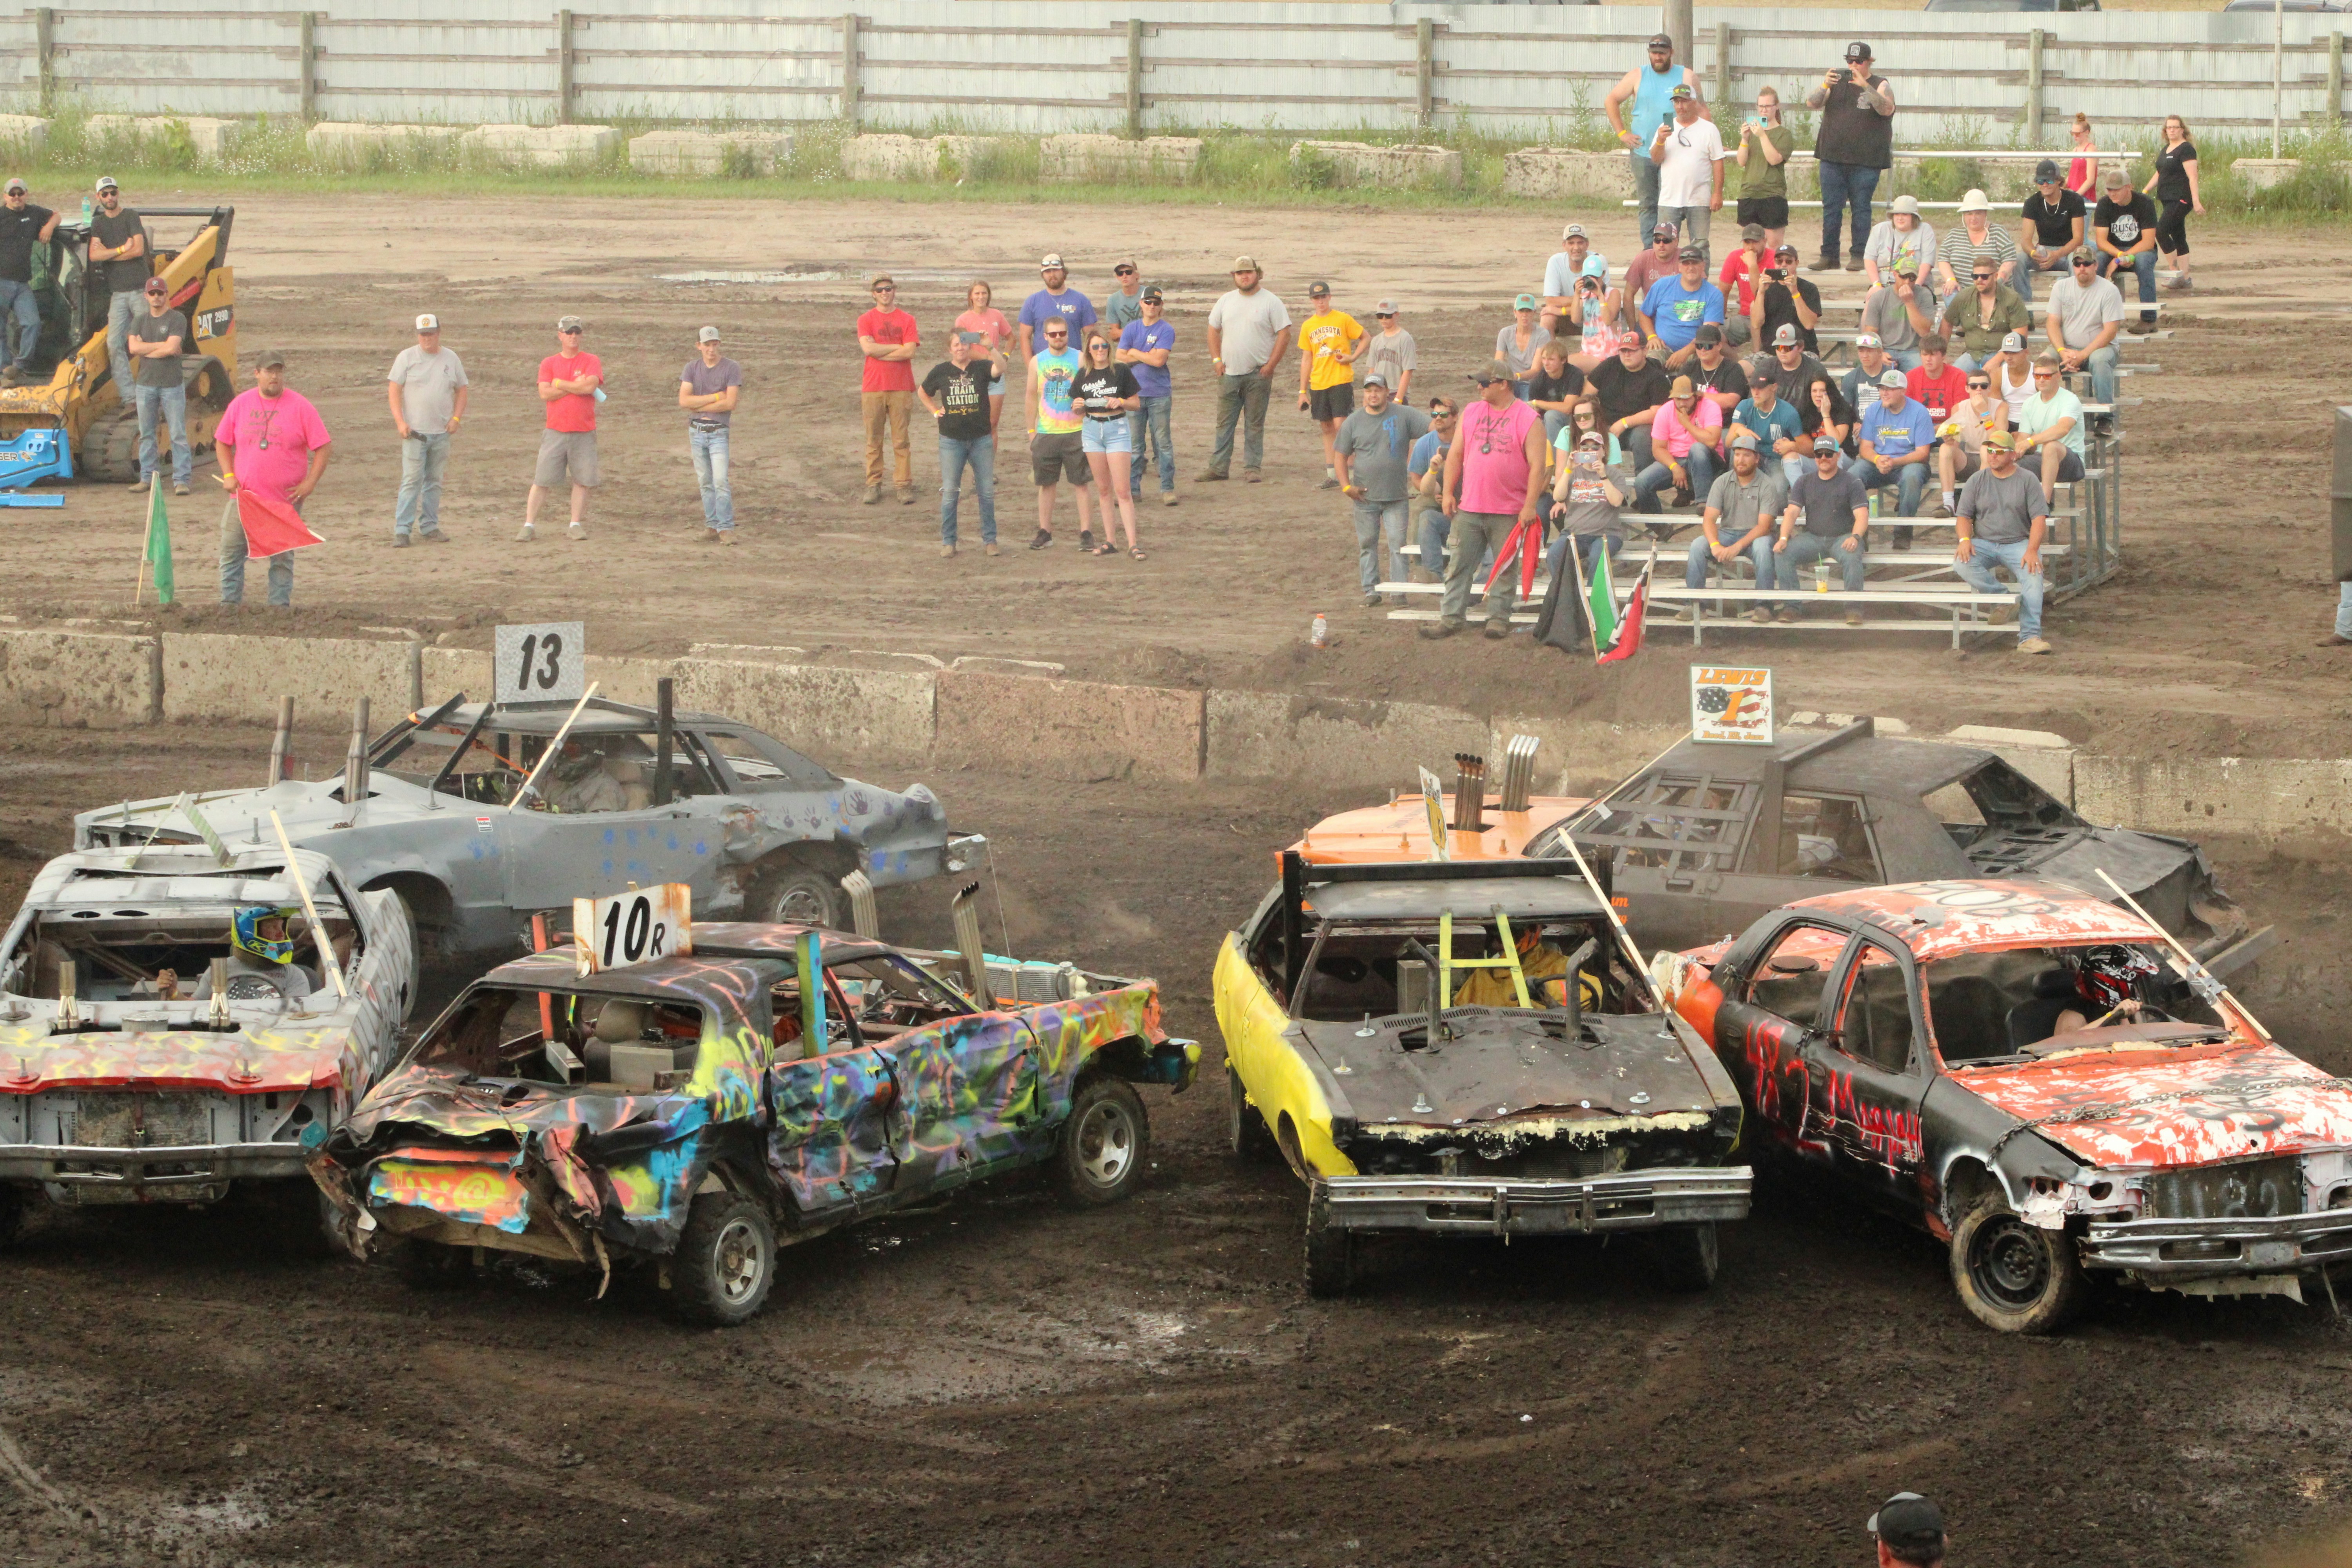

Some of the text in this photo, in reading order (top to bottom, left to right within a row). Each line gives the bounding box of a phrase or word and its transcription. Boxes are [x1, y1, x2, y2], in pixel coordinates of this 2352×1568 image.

[2112, 223, 2139, 232] BUSCH
[1309, 327, 1341, 342] MINNESOTA
[949, 385, 975, 396] TRAIN
[1082, 378, 1107, 392] Interstate
[1091, 387, 1118, 397] Raceway
[946, 394, 979, 406] STATION
[519, 633, 562, 690] 13
[1695, 668, 1768, 685] LEWIS
[1719, 691, 1744, 721] 1
